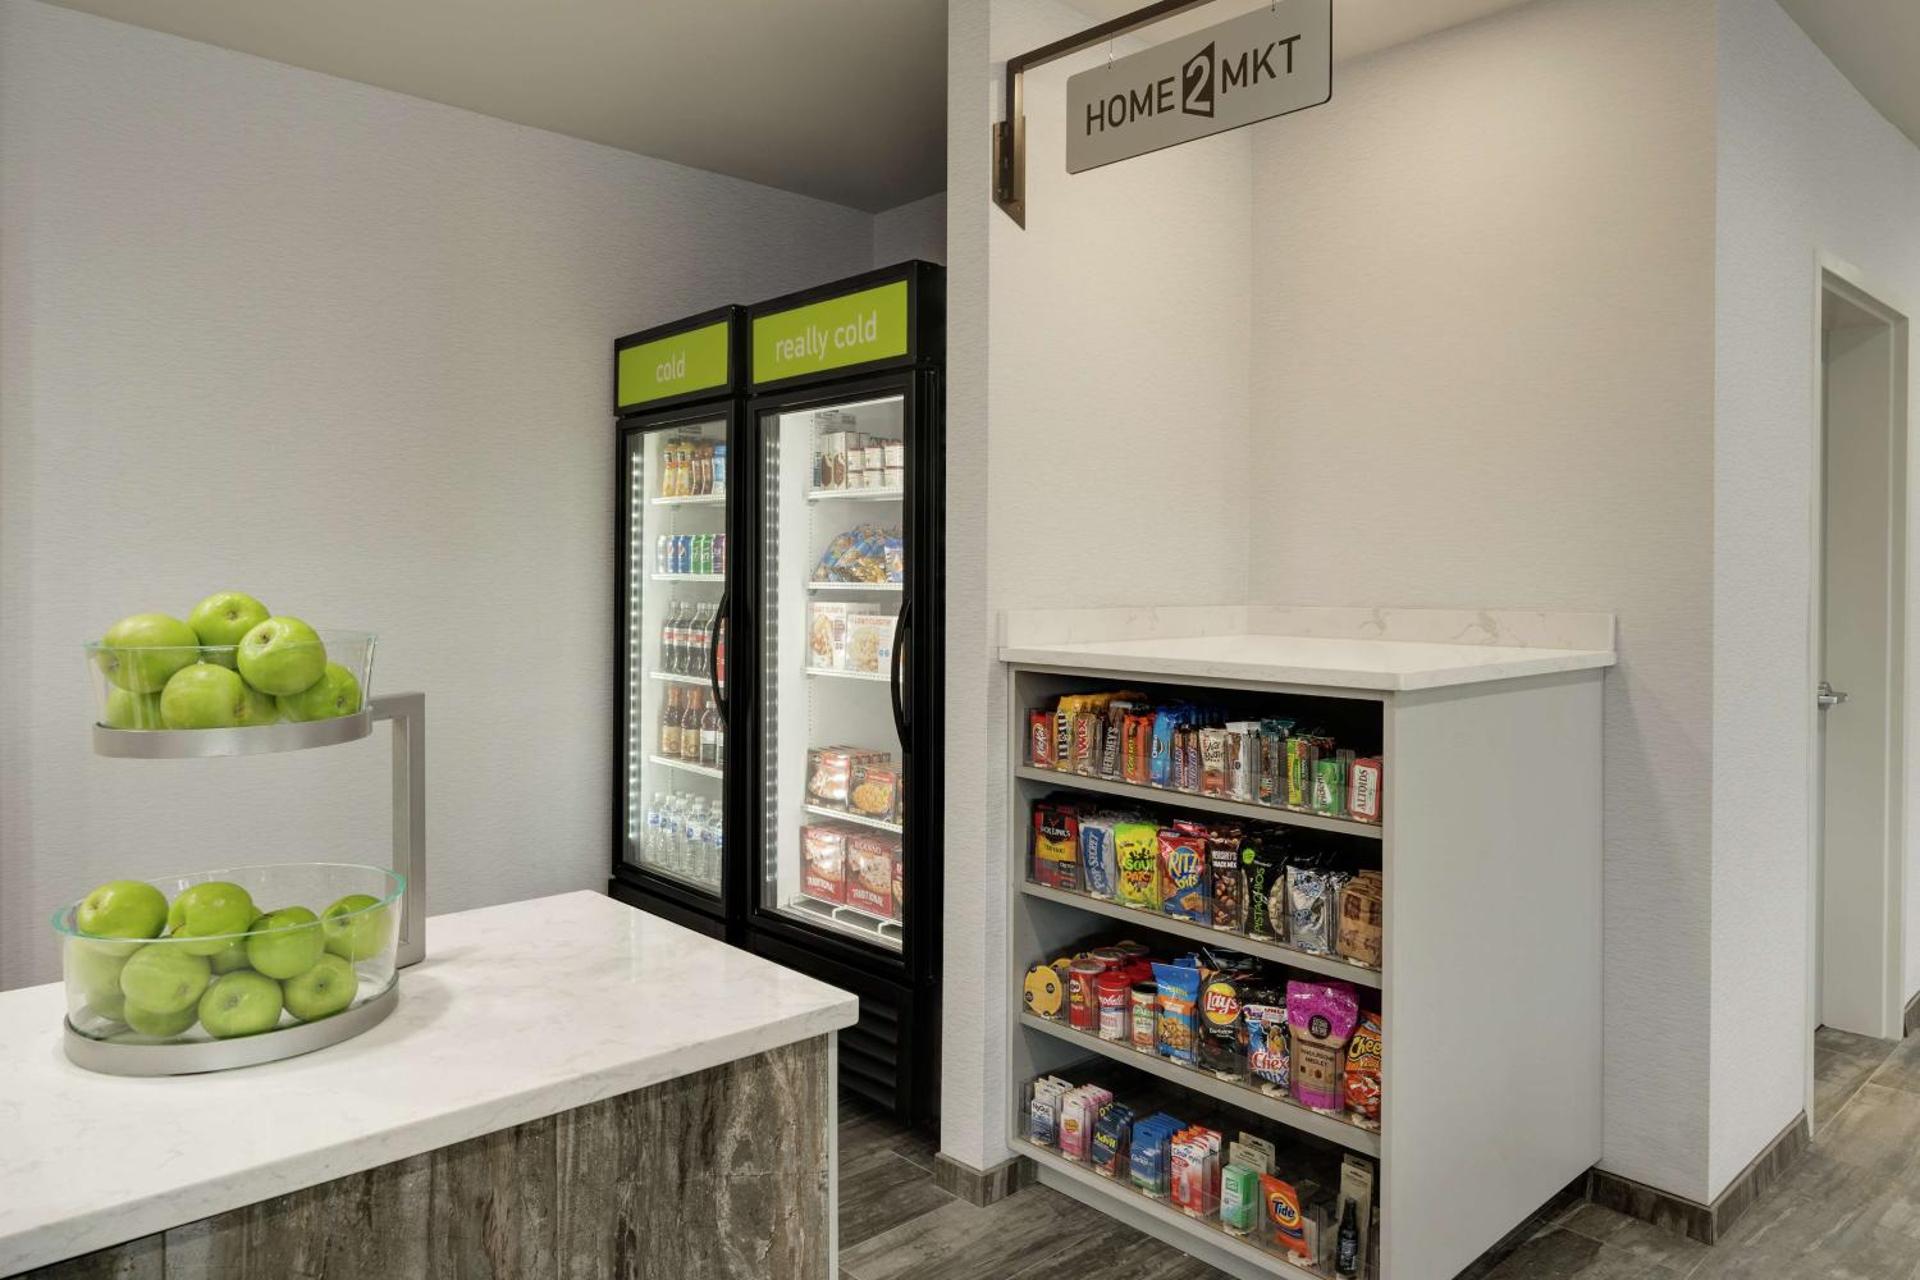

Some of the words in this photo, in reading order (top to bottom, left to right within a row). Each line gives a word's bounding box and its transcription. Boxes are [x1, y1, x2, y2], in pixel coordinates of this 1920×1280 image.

[776, 325, 829, 362] really
[834, 310, 877, 349] cold
[656, 350, 686, 383] cold
[1356, 768, 1369, 812] ALTOIDS
[1169, 851, 1199, 878] RITZ
[1252, 1051, 1290, 1069] Chex
[1271, 1200, 1295, 1218] Tide
